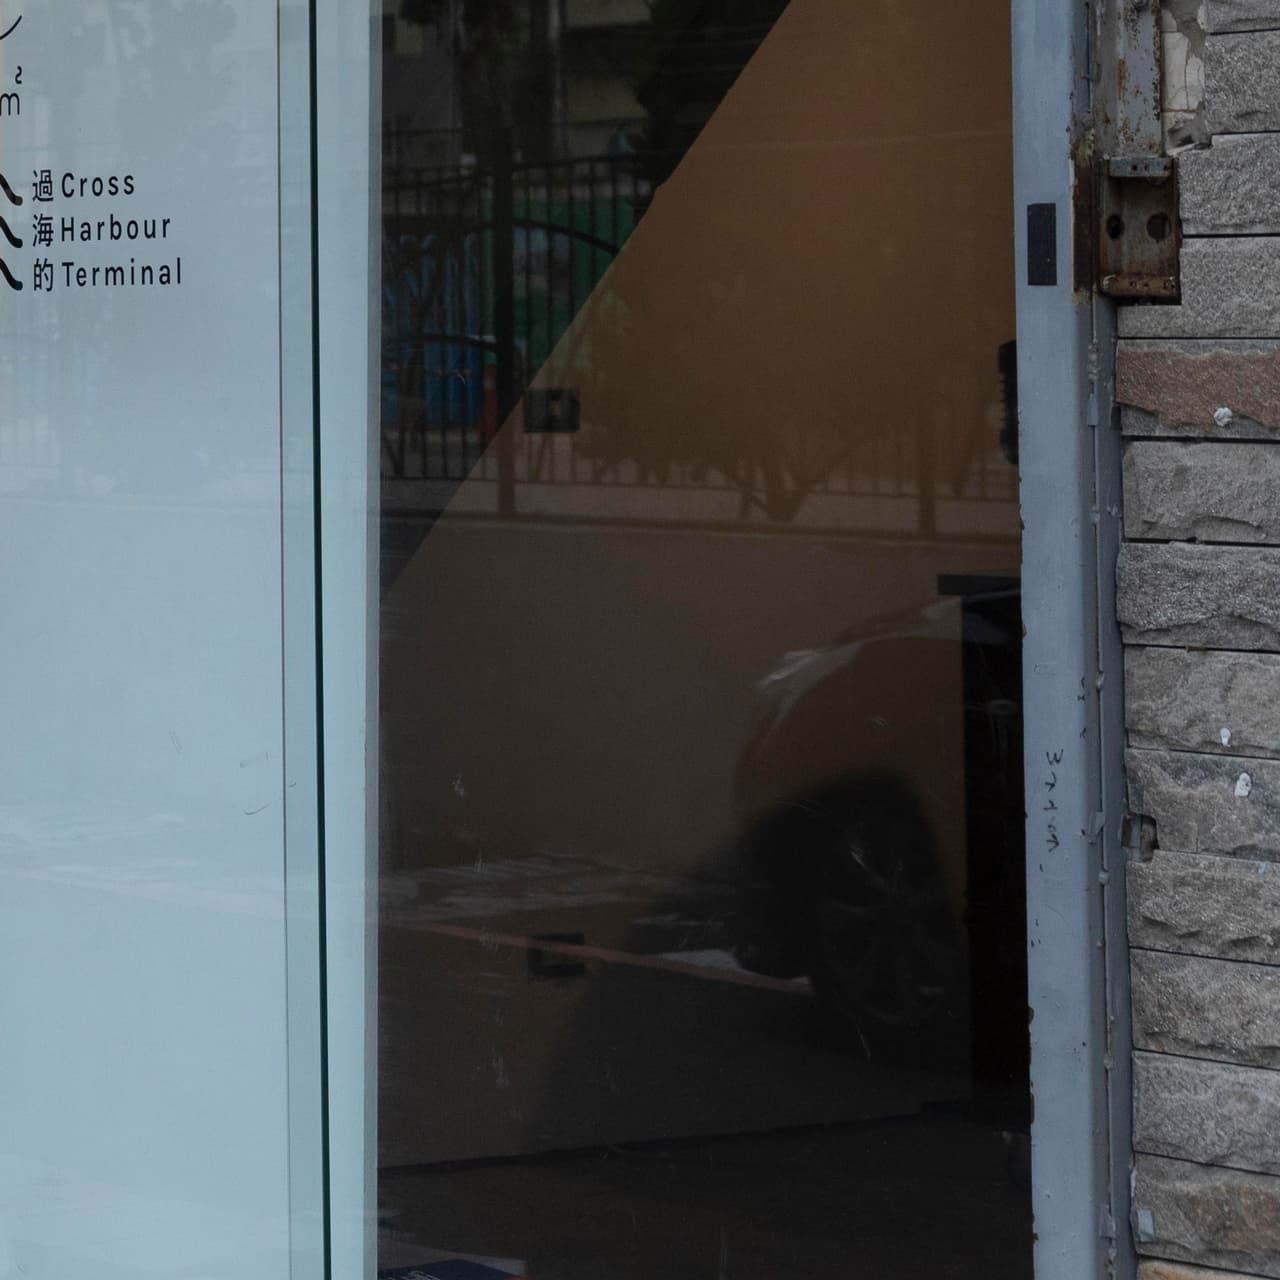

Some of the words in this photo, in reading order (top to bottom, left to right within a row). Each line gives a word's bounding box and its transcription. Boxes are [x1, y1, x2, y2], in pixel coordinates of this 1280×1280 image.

[61, 172, 135, 198] Cross
[61, 214, 171, 242] Harbour
[61, 257, 182, 287] Terminal
